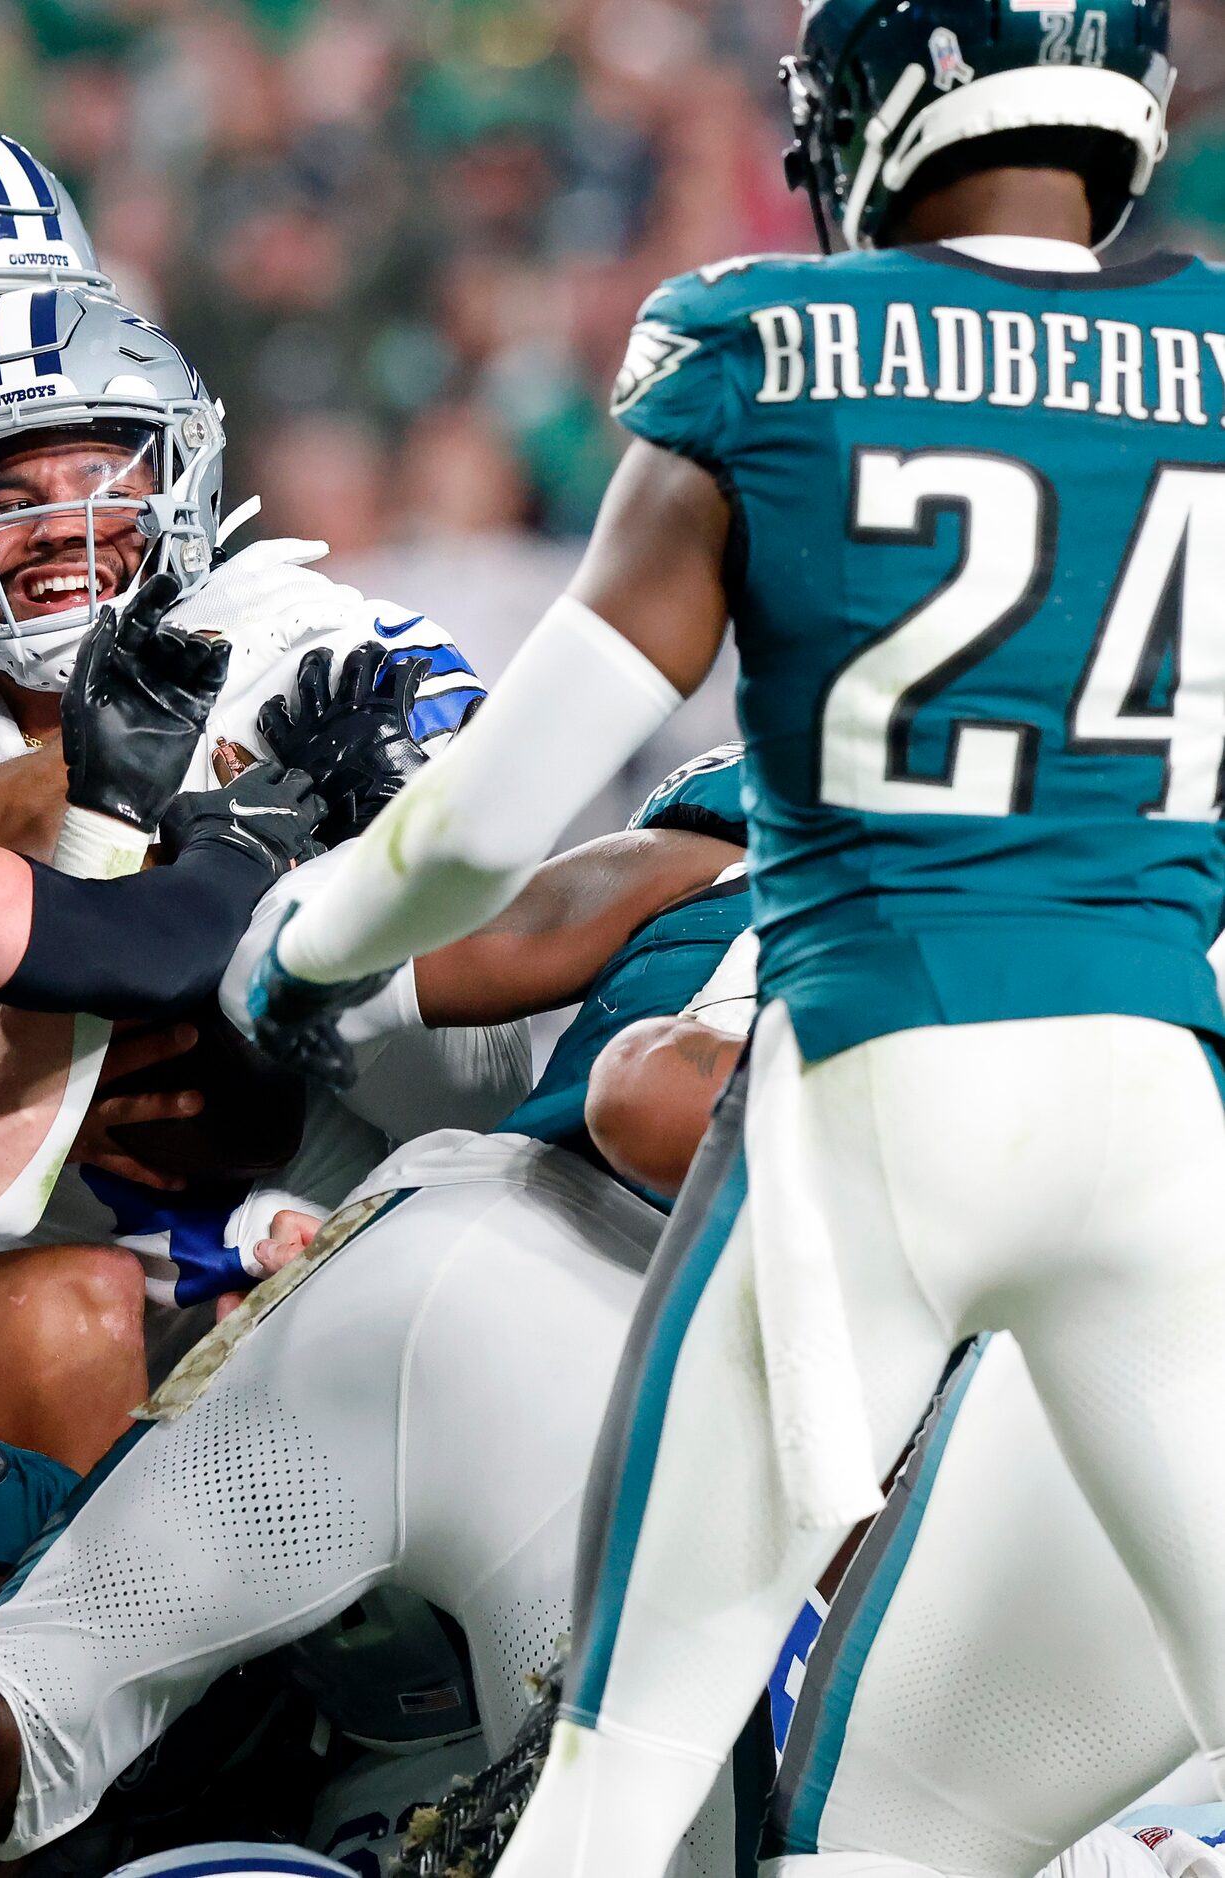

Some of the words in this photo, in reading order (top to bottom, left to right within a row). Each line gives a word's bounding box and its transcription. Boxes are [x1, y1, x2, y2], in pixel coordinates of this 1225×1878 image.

[1038, 10, 1108, 67] 24
[8, 253, 69, 267] COWBOYS
[817, 448, 1225, 825] 24
